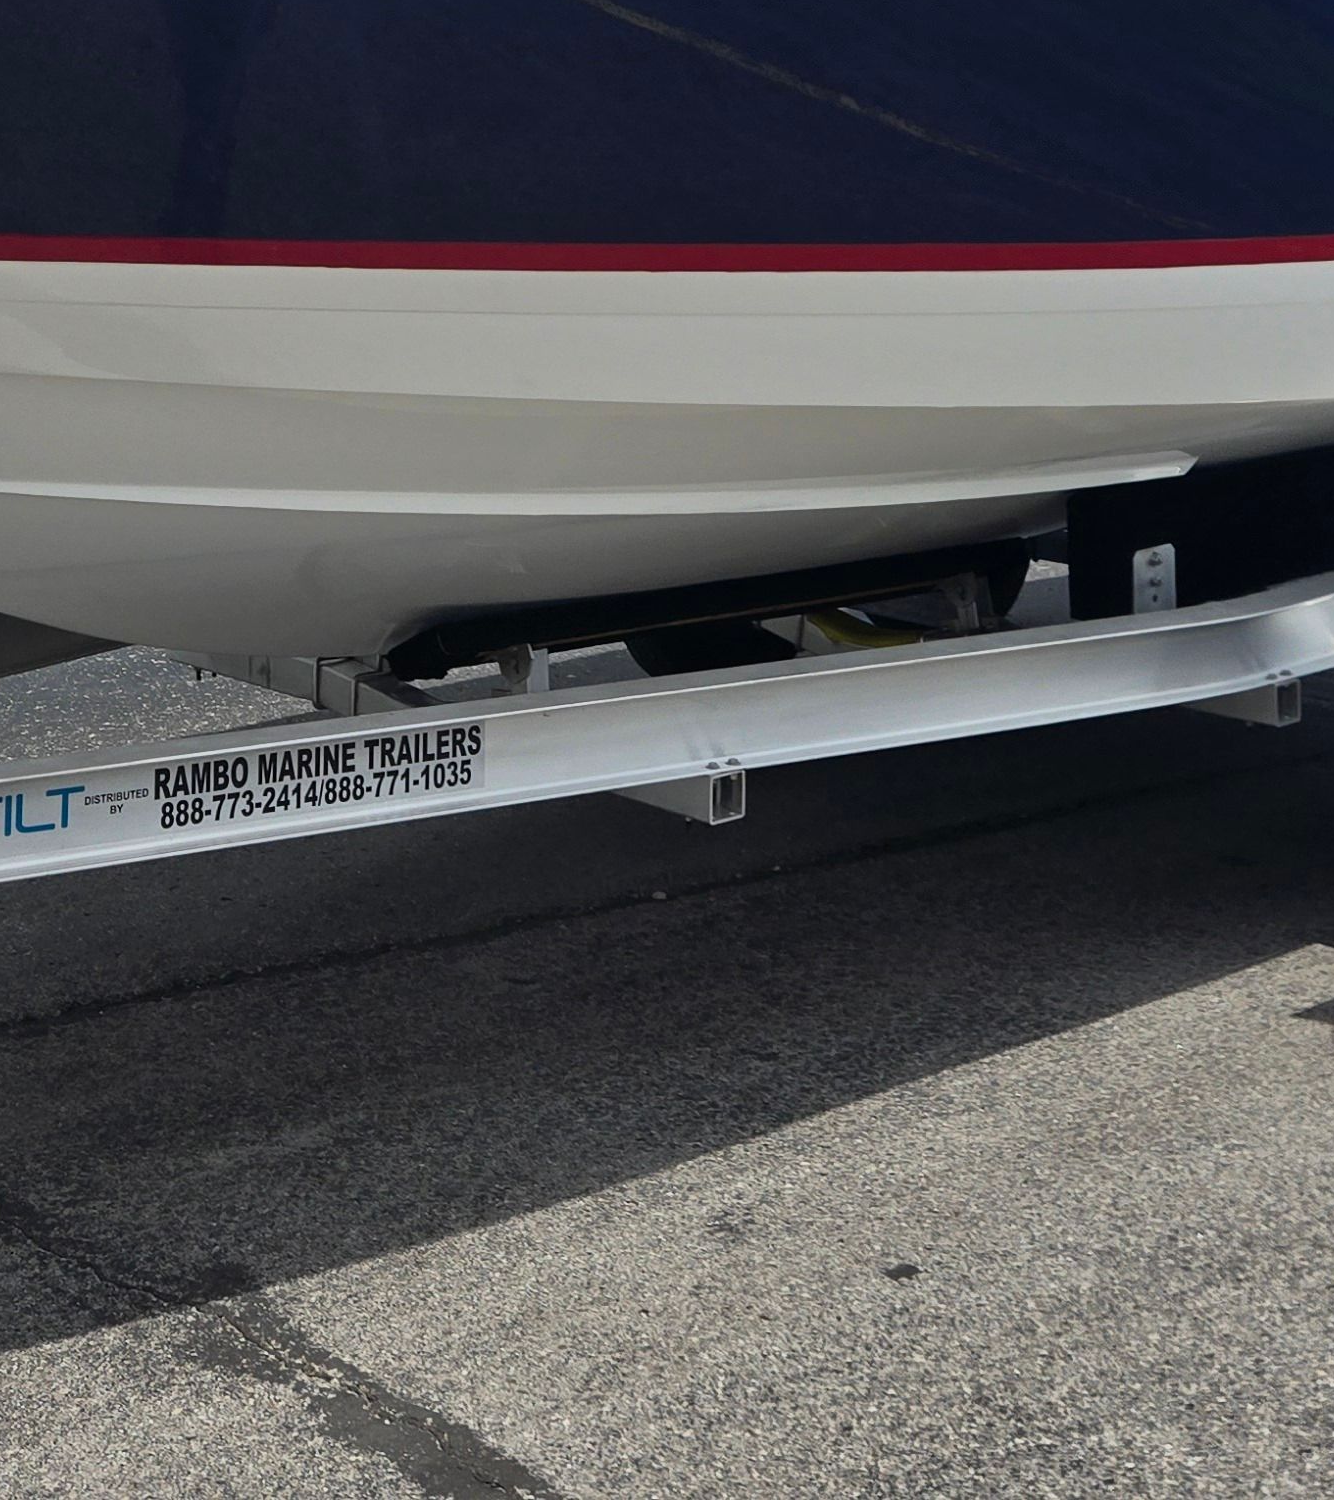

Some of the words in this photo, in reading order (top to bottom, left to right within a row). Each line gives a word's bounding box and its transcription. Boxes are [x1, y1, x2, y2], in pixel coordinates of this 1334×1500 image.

[154, 756, 248, 800] RAMBO
[258, 741, 356, 785] MARINE
[364, 724, 482, 771] TRAILERS
[84, 787, 150, 806] DISTRIBUTED
[109, 803, 124, 816] BY
[160, 759, 472, 829] 888-773-2414/888-771-1035
